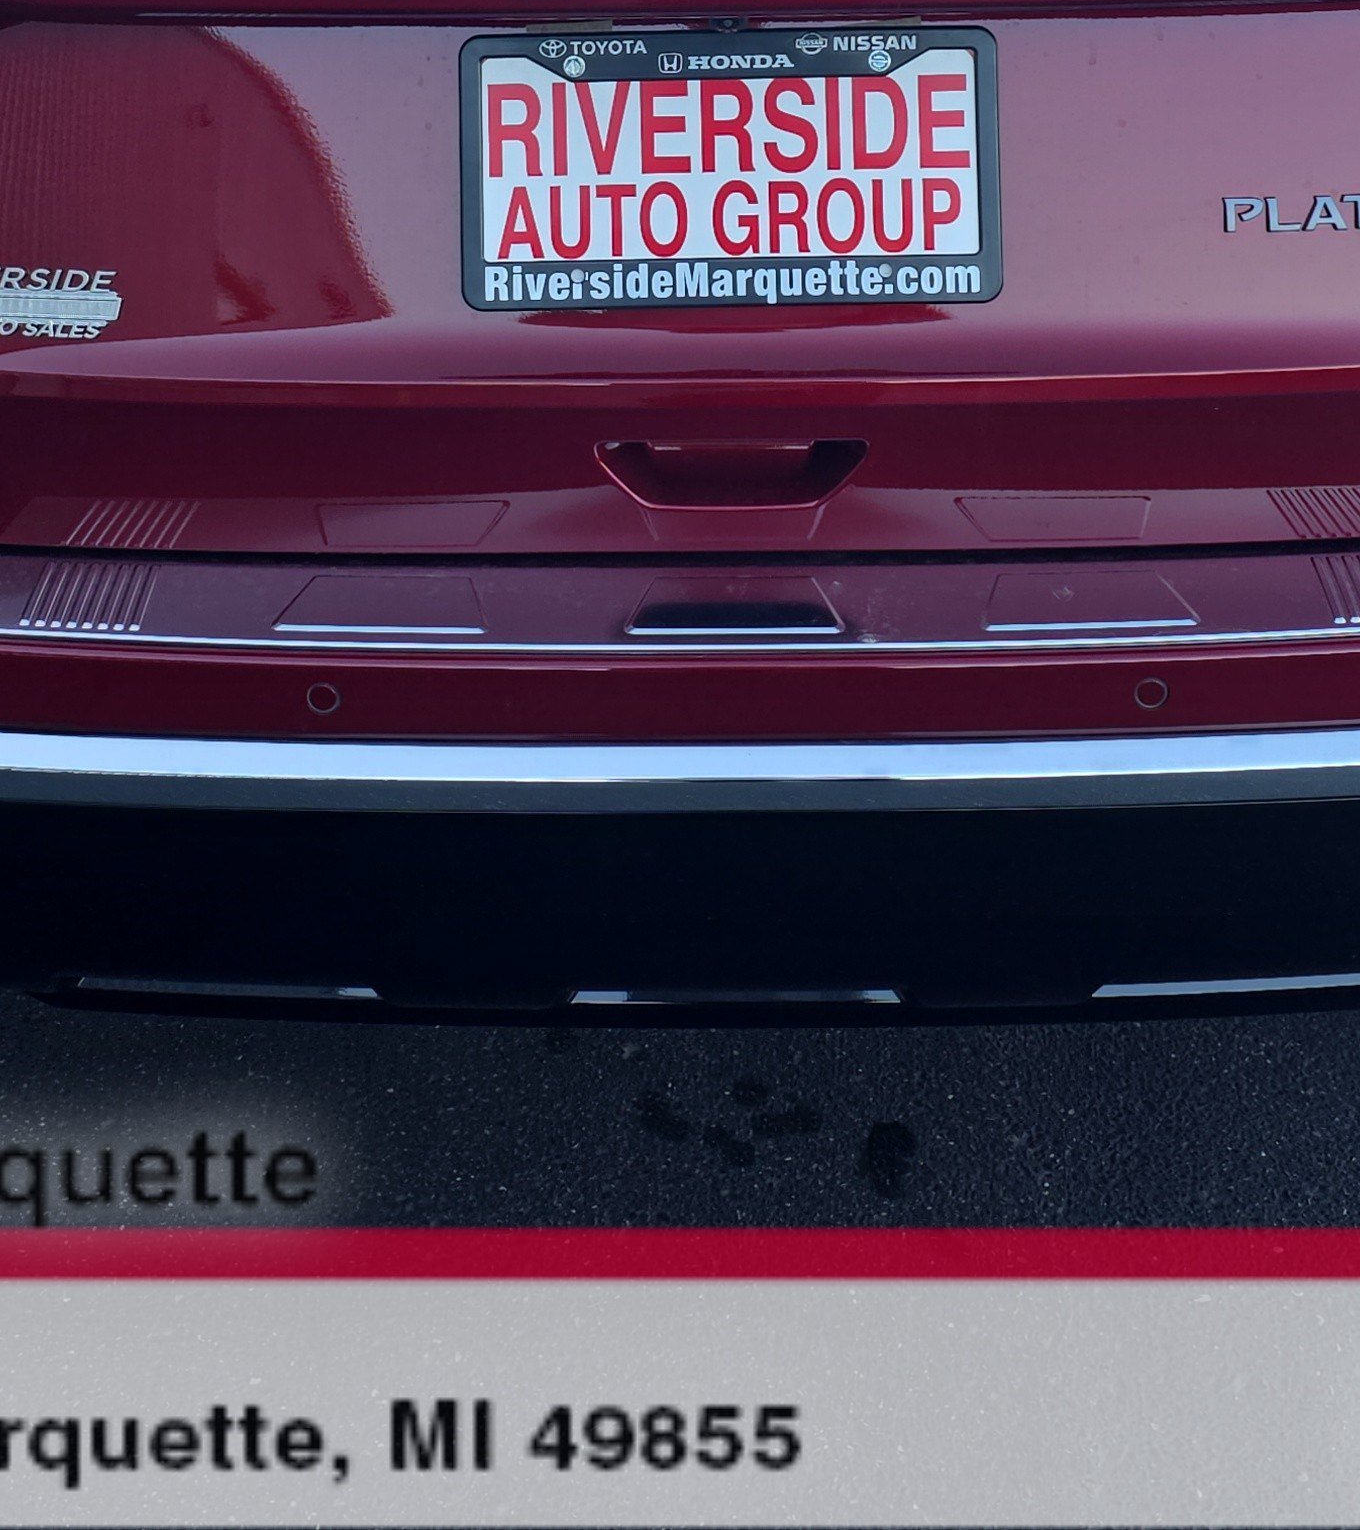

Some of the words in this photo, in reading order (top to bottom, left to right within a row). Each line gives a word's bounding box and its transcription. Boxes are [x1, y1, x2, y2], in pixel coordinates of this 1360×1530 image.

[569, 39, 648, 56] TOYOTA
[832, 34, 917, 51] NISSAN
[688, 54, 795, 70] HONDA
[486, 73, 972, 178] RIVERSIDE
[497, 179, 688, 260] AUTO
[711, 176, 962, 255] GROUP
[483, 261, 982, 305] RiversideMarquette.com
[21, 320, 102, 339] SALES
